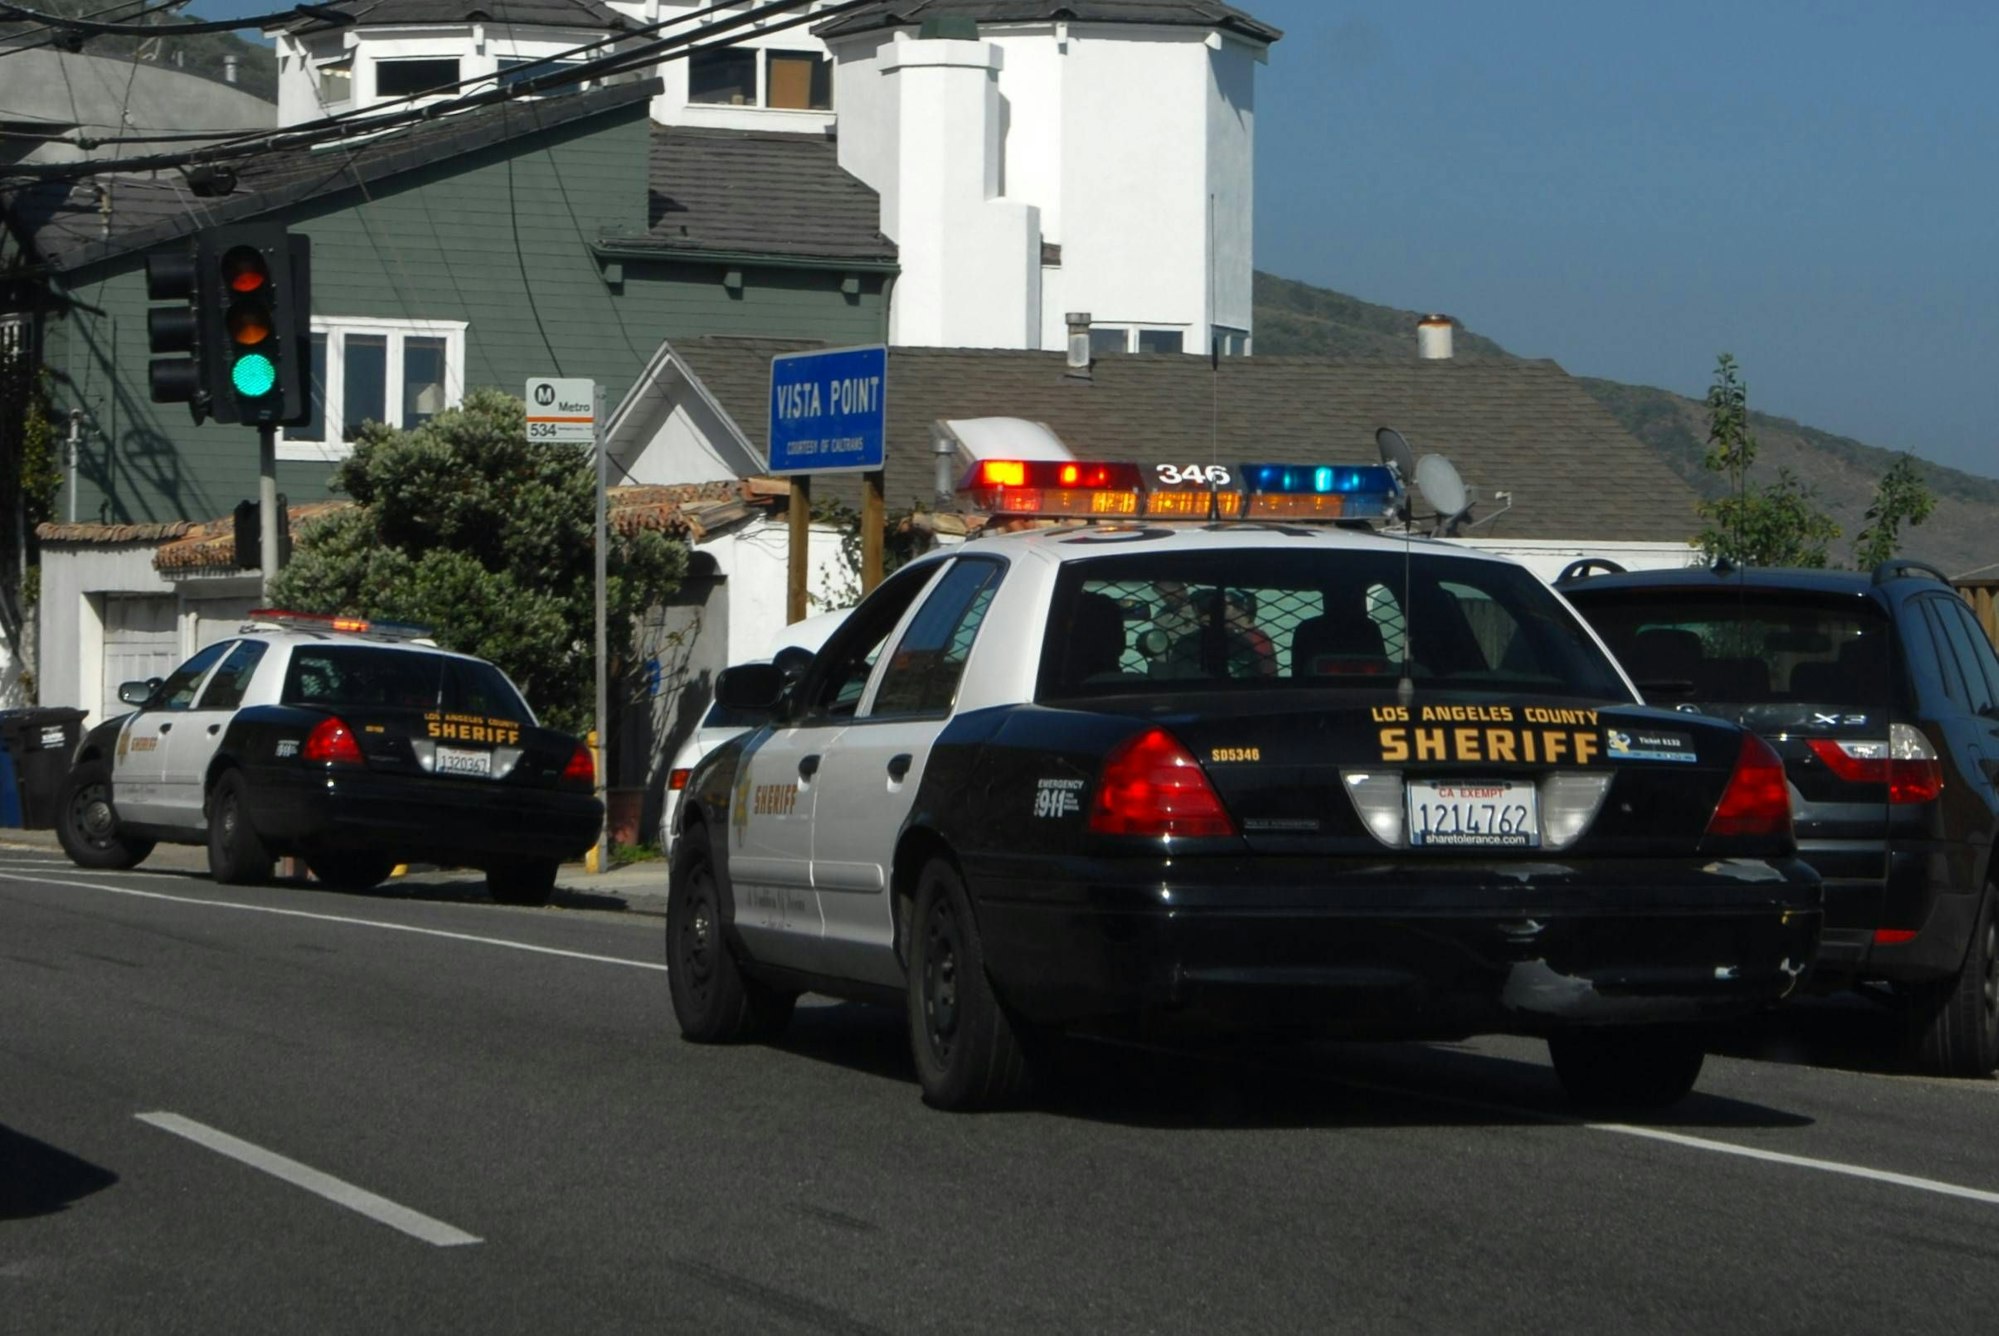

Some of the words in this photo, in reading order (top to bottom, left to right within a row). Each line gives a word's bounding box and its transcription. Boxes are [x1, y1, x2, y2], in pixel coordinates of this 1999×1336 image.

[558, 402, 591, 412] Metro
[777, 382, 821, 419] VISTA
[830, 376, 880, 416] POINT
[530, 423, 557, 437] 534
[820, 439, 830, 453] OF
[1156, 463, 1231, 485] 346
[1371, 706, 1410, 722] LOS
[1422, 706, 1514, 722] ANGELES
[1524, 707, 1598, 725] COUNTY
[428, 722, 519, 745] SHERIFF
[1379, 728, 1599, 764] SHERIFF
[754, 784, 798, 815] SHERIFF
[1438, 788, 1454, 798] CA
[1460, 788, 1505, 798] EXEMPT
[1419, 803, 1528, 834] 1214762
[1425, 834, 1526, 845] sharetolerance.com
